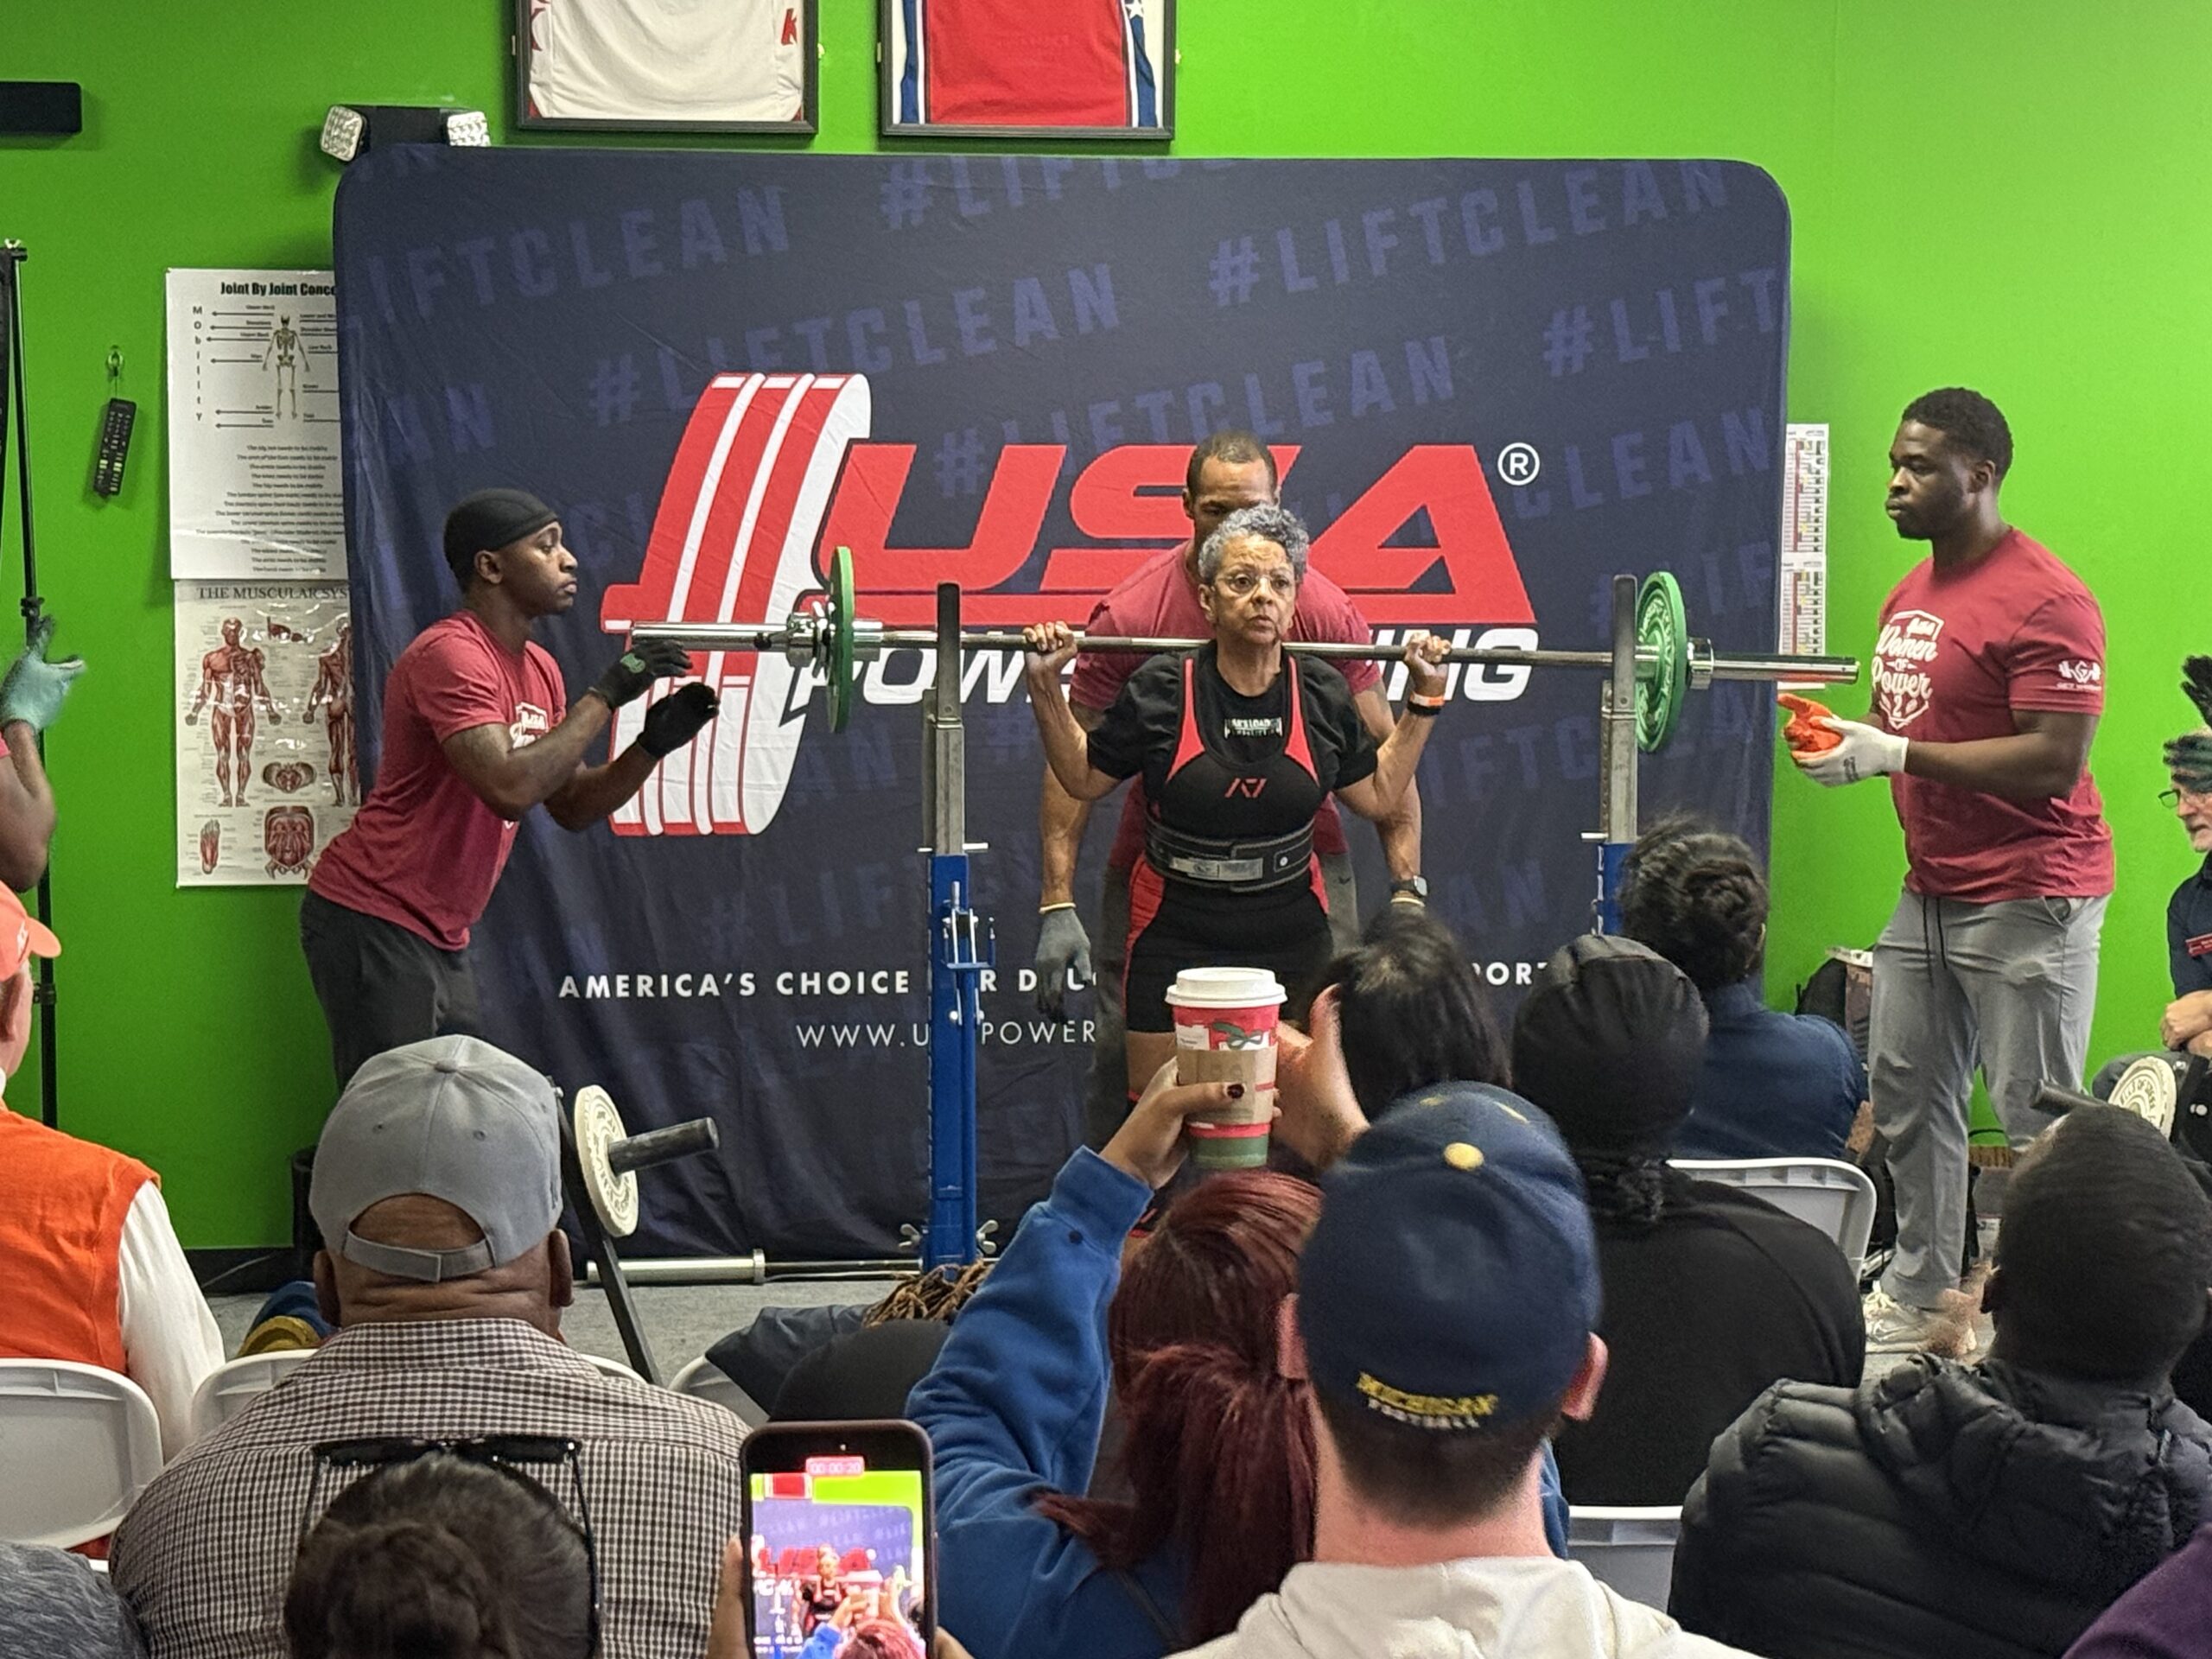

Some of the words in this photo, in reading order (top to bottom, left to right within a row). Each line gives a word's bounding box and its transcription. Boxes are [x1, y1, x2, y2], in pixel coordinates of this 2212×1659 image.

[346, 185, 789, 326] IFTCLEAN
[221, 282, 249, 295] Joint
[251, 282, 267, 296] By
[269, 283, 298, 296] Joint
[197, 587, 230, 600] THE
[233, 587, 317, 600] MUSCULAR
[1876, 623, 1938, 662] Women
[1872, 655, 1933, 699] Power
[559, 972, 757, 999] AMERICA'S
[777, 969, 910, 996] CHOICE
